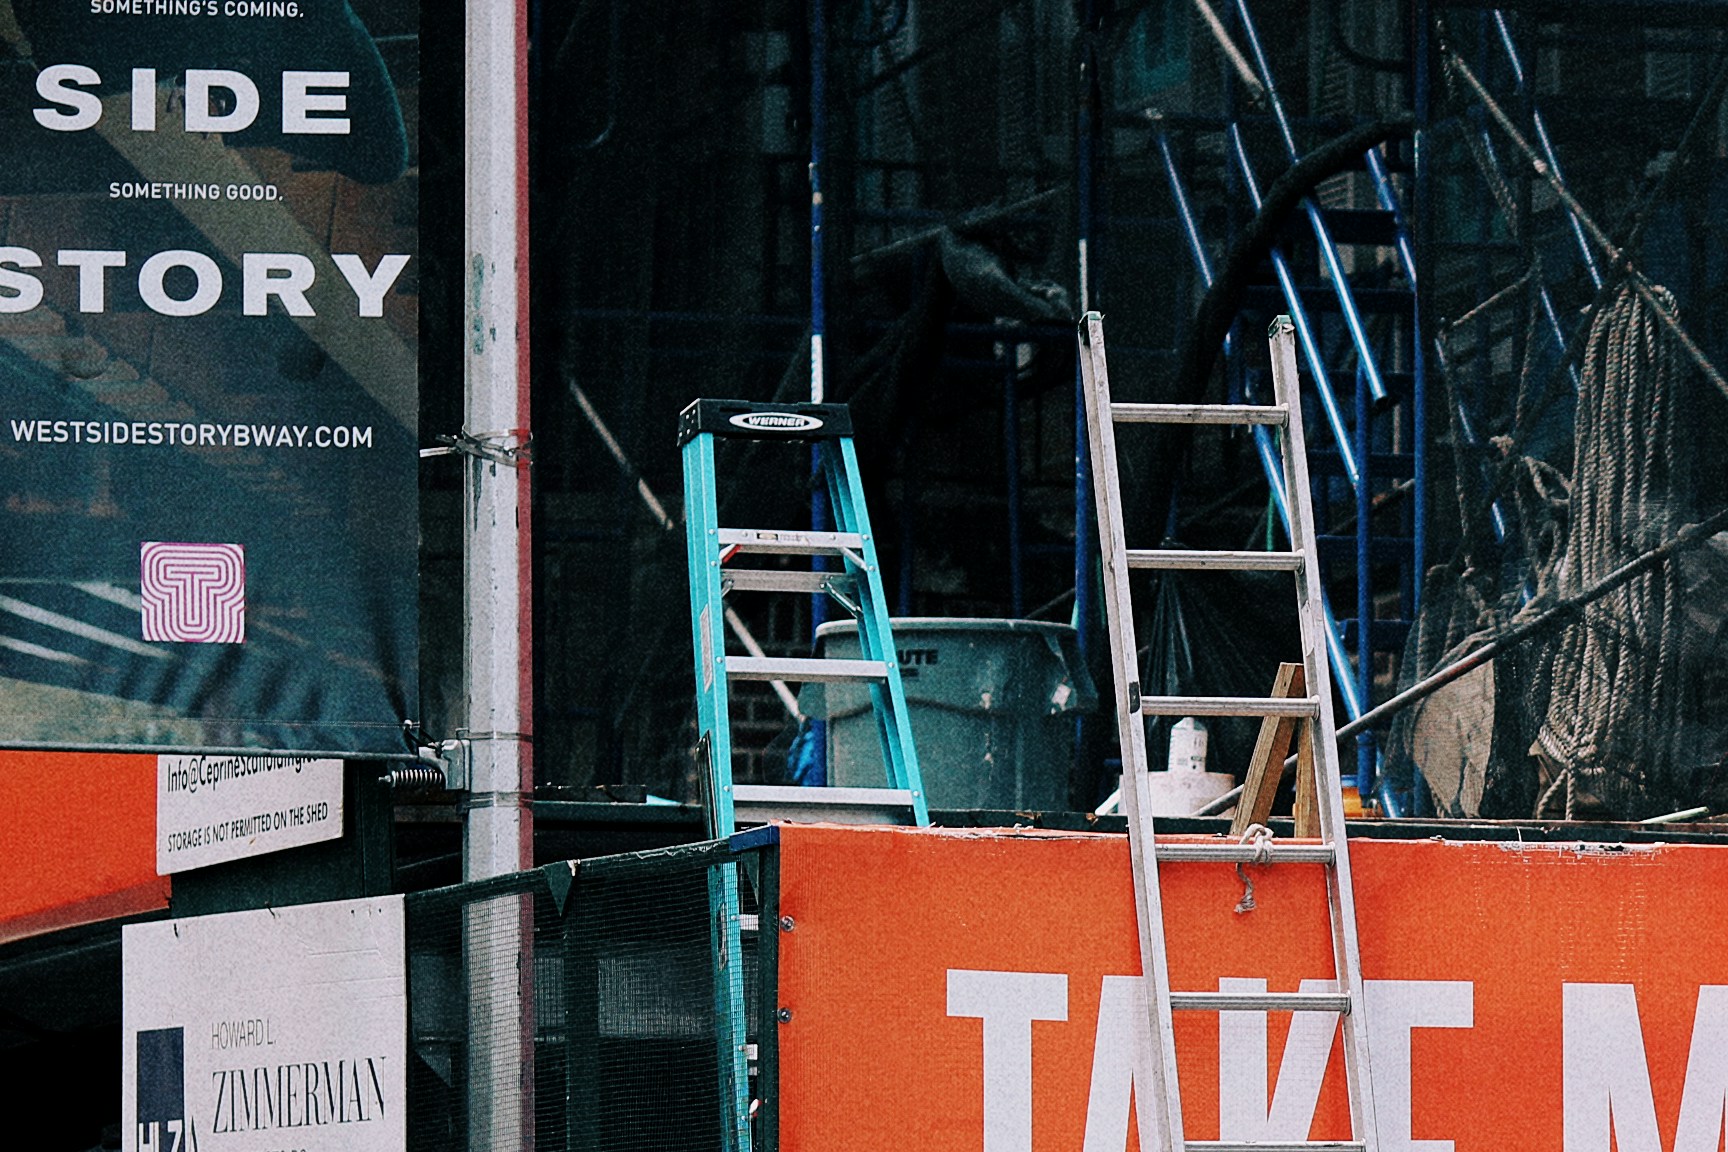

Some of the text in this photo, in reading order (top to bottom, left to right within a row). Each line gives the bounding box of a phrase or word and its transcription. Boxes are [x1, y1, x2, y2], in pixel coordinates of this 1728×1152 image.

[33, 64, 350, 133] SIDE
[109, 182, 220, 200] SOMETHING
[0, 246, 411, 318] STORY
[11, 419, 373, 448] WESTSIDESTORYBWAY.COM
[749, 416, 804, 428] WERNER
[167, 801, 328, 852] STORAGE IS NOT PERMITTED ON THE SHED
[211, 1018, 276, 1049] HOWARD L.
[212, 1056, 387, 1133] ZIMMERMAN
